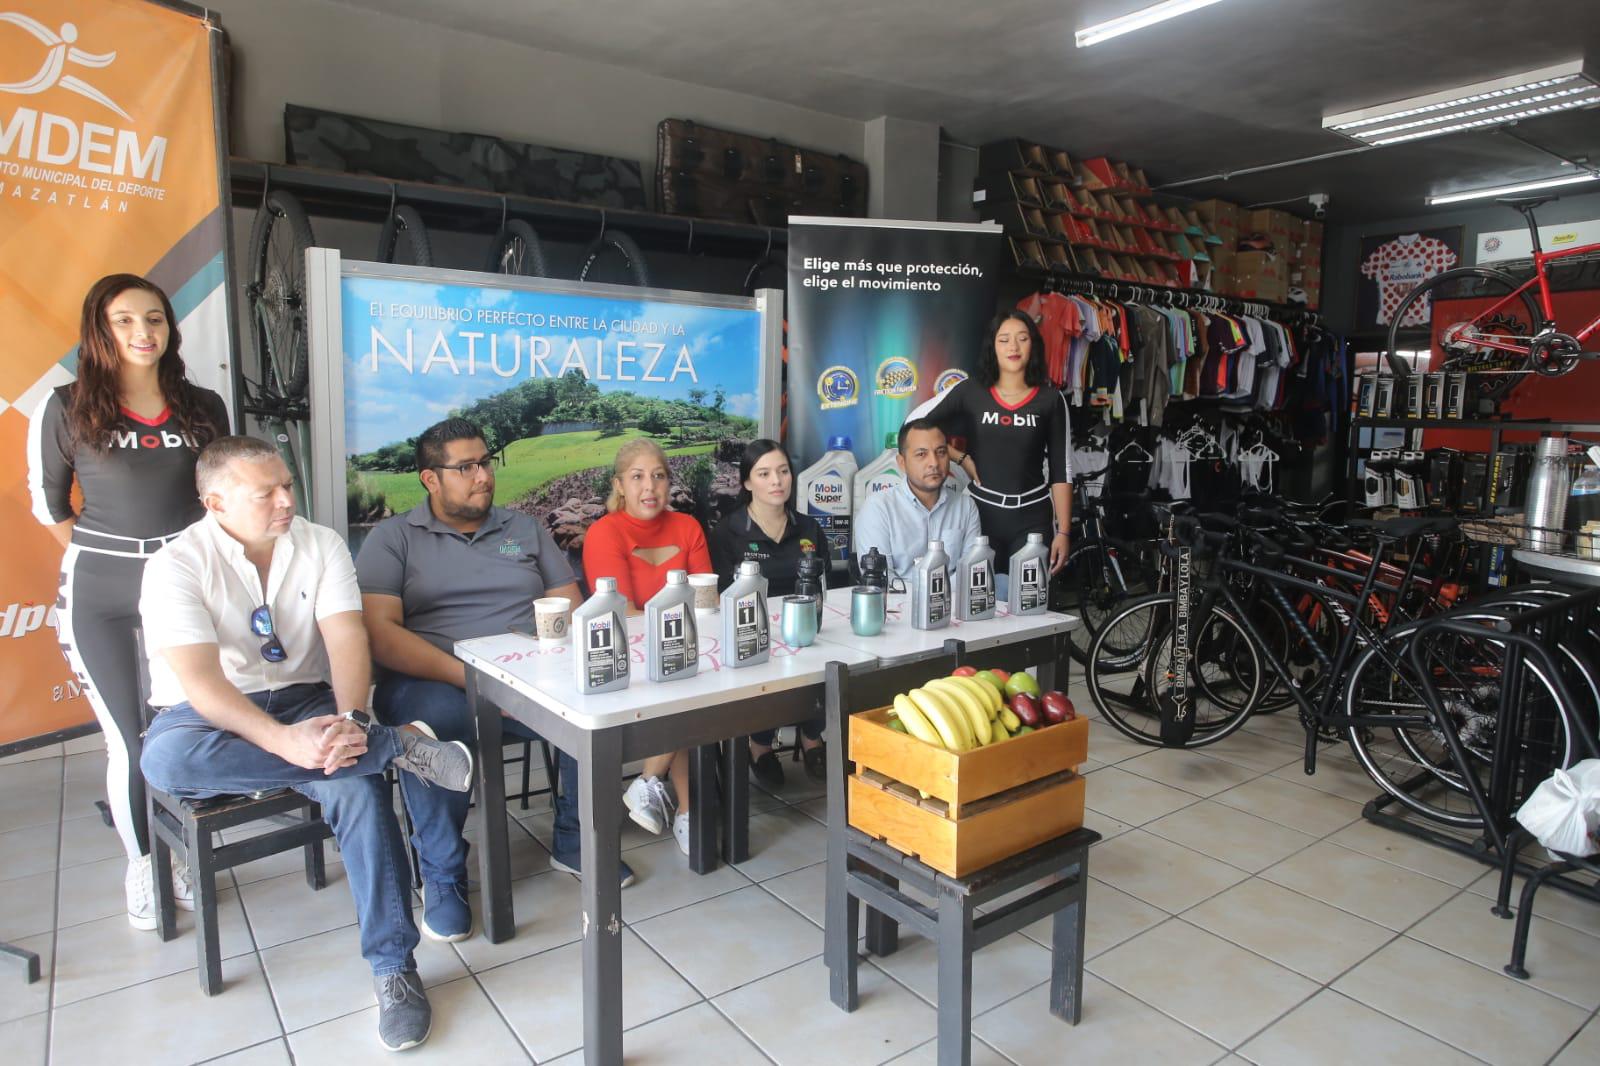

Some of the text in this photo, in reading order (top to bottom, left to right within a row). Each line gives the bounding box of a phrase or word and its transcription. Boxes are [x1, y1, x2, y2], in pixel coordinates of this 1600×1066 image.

[22, 165, 88, 189] MUNICIPAL
[91, 178, 114, 193] DEL
[117, 181, 166, 201] DEPORTE
[803, 257, 984, 278] Elige más que protección,
[803, 275, 942, 292] elige el movimiento
[370, 302, 686, 337] EL EQUILIBRIO PERFECTO ENTRE LA CIUDAD Y LA
[370, 327, 699, 384] NATURALEZA
[981, 411, 1037, 427] Mobil
[815, 483, 843, 493] Mobil
[815, 493, 843, 503] Super
[976, 573, 982, 586] 1
[1027, 569, 1033, 582] 1
[935, 579, 940, 593] 1
[743, 608, 750, 624] 1
[590, 620, 611, 630] Mobil
[669, 620, 677, 637] 1
[596, 630, 605, 647] 1
